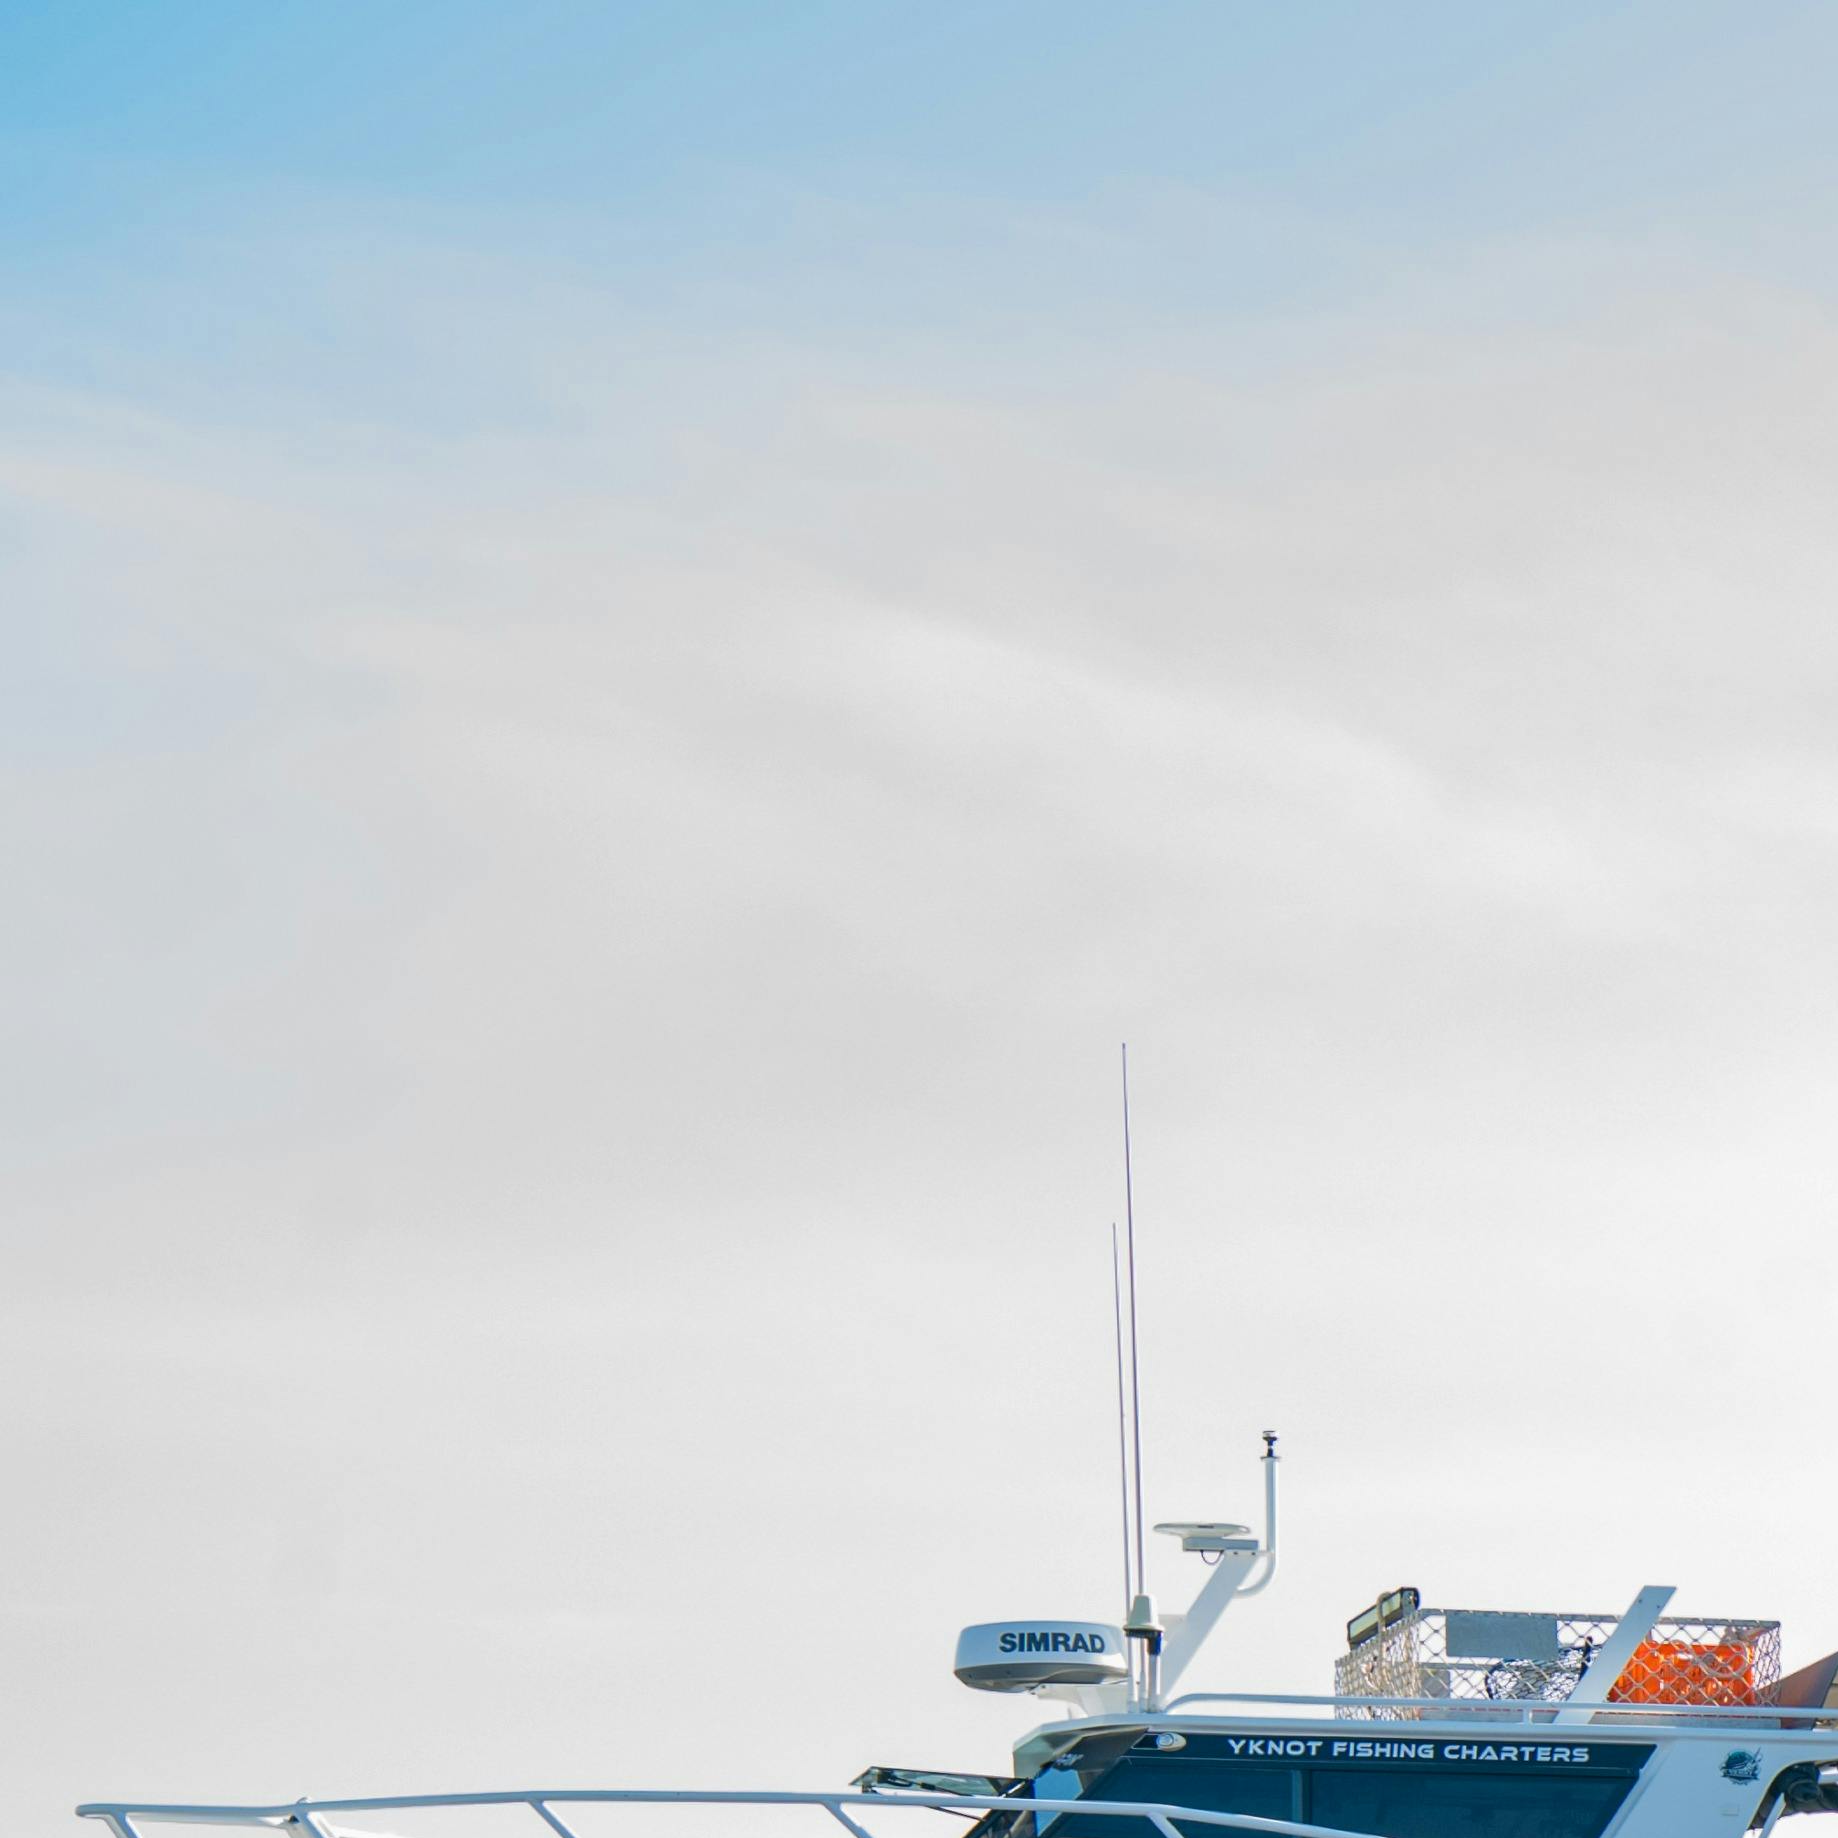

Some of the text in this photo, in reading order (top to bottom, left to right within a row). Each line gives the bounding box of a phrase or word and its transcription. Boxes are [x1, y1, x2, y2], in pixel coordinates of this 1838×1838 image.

[998, 1631, 1105, 1654] SIMRAD
[1228, 1738, 1591, 1764] YKNOT FISHING CHARTERS
